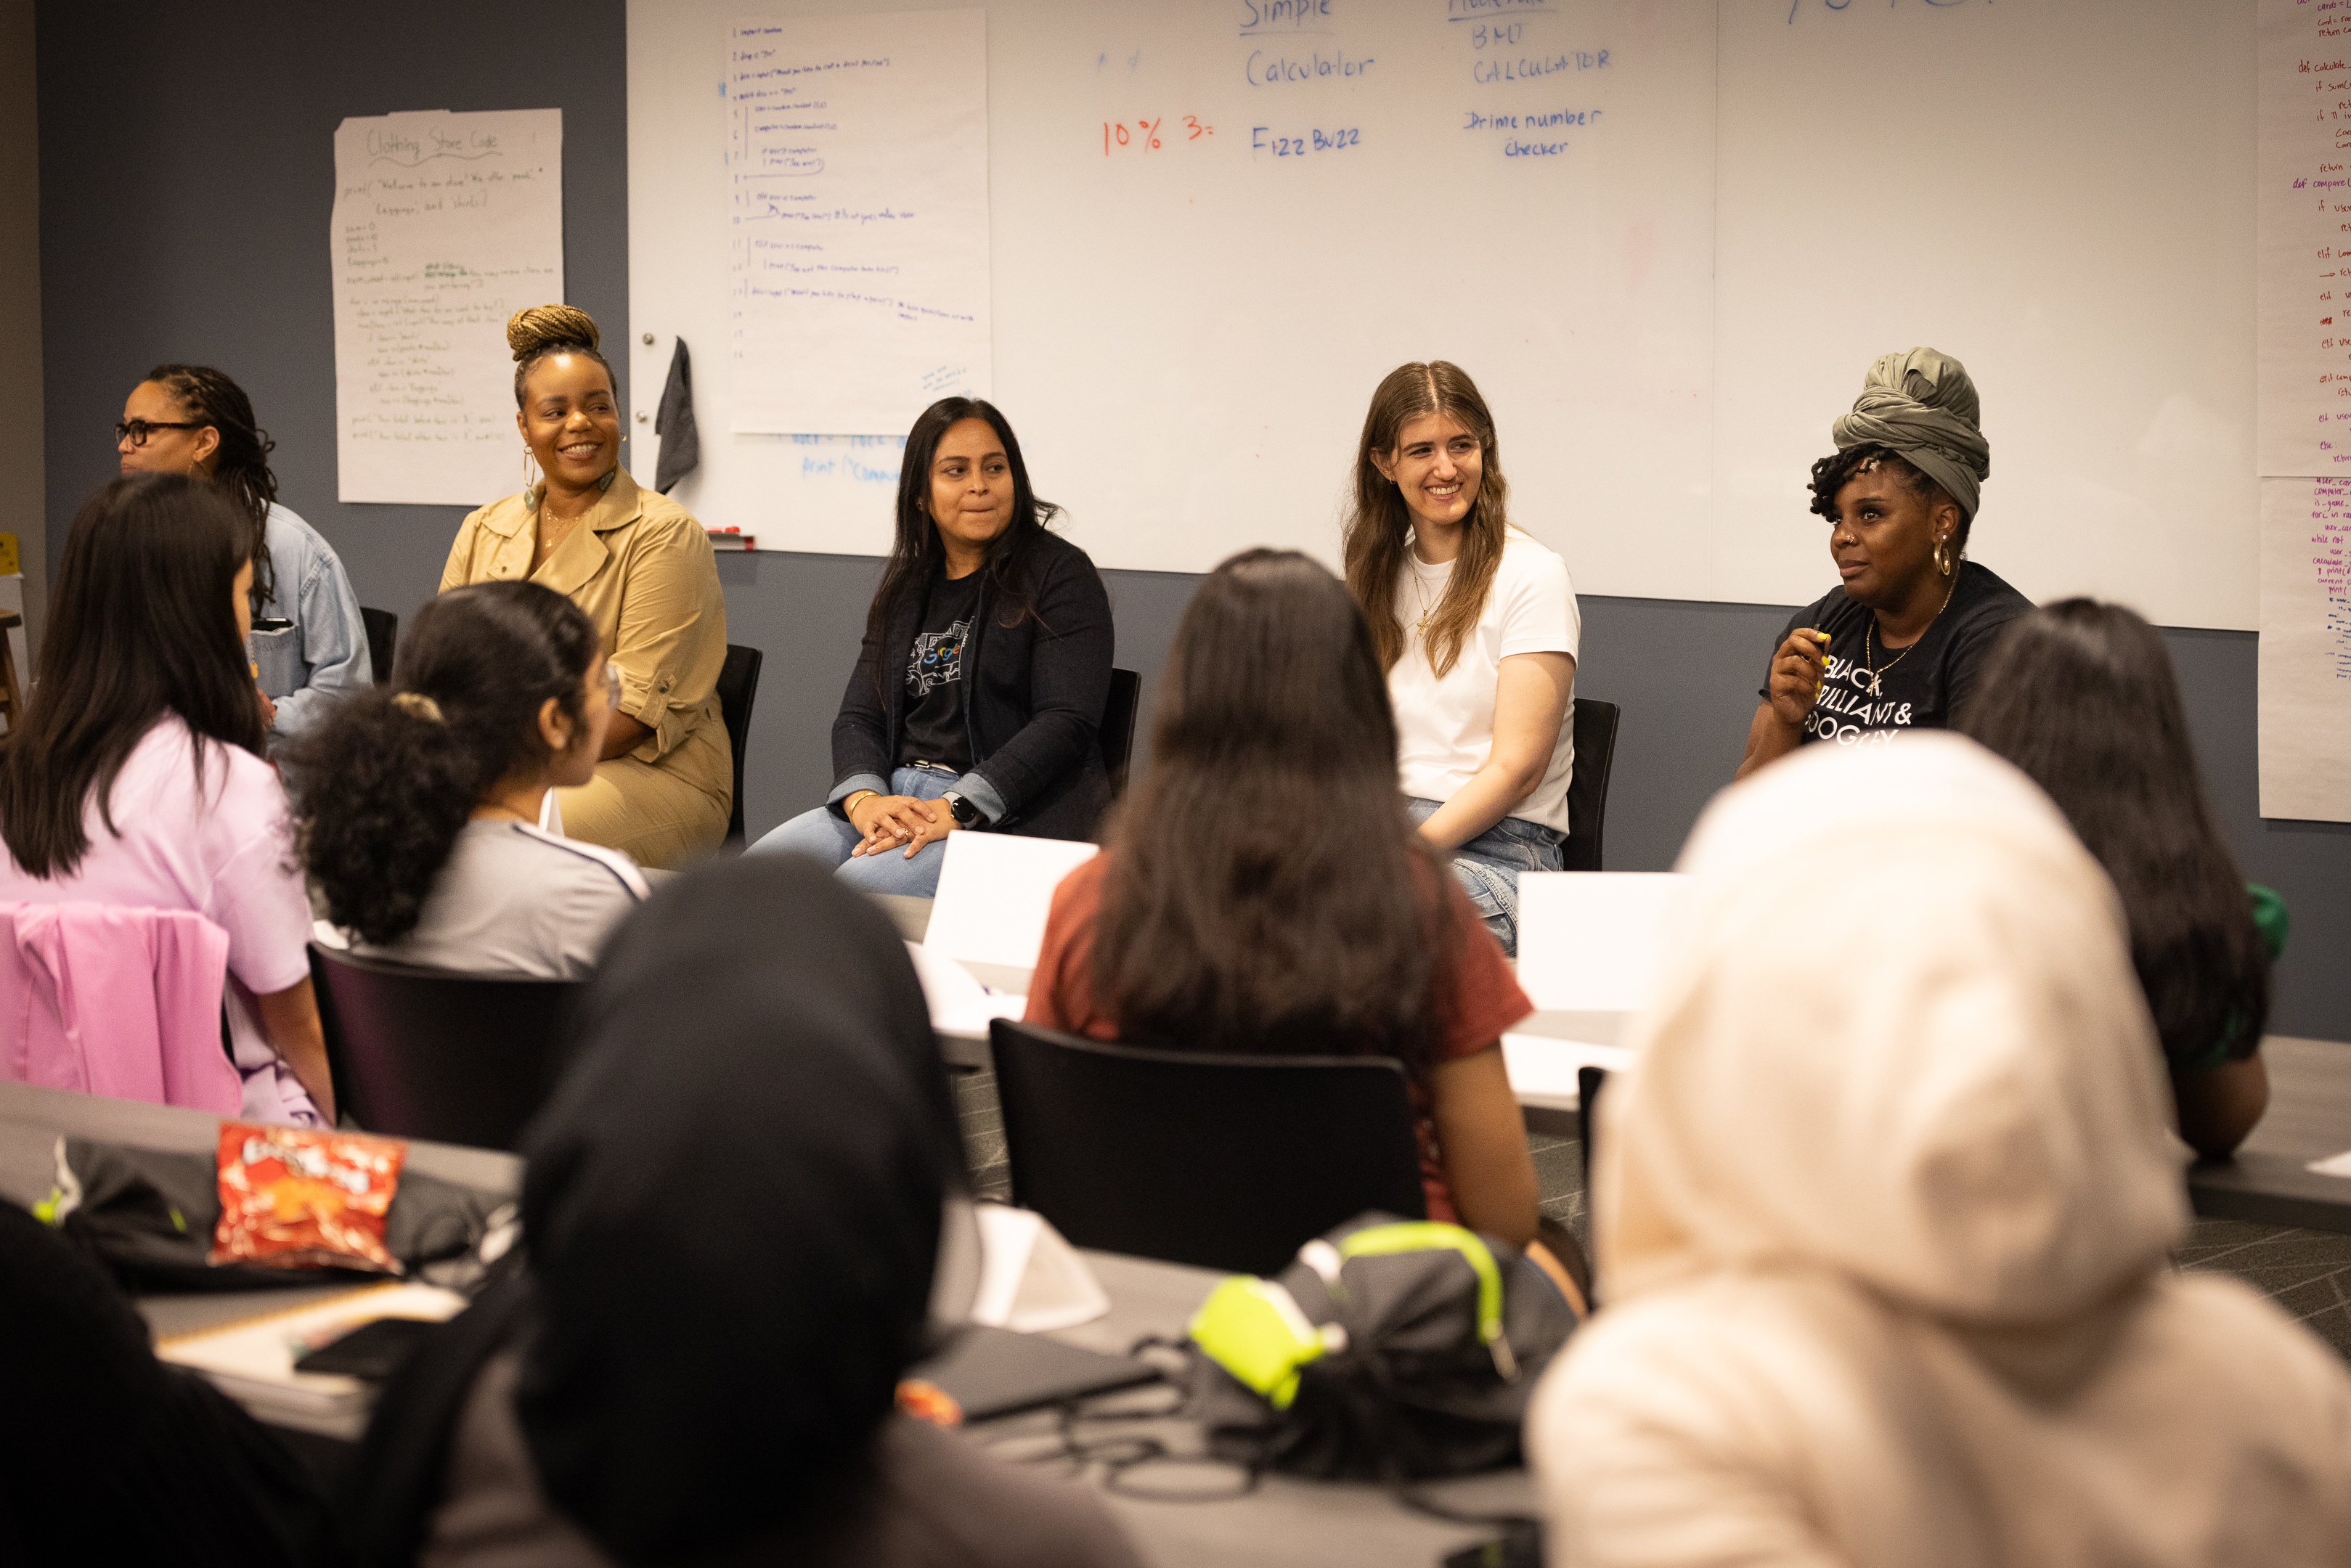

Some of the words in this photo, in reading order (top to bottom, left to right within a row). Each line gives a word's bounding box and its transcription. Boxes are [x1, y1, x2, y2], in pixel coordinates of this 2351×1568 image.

[1239, 0, 1332, 28] Simple
[1246, 49, 1375, 86] Calculator
[1474, 49, 1610, 84] CALCULATOR
[2299, 60, 2310, 73] def
[1525, 108, 1602, 128] number
[367, 128, 420, 160] Clothing
[428, 125, 463, 150] Store
[2320, 163, 2343, 173] return
[1894, 703, 1912, 725] &
